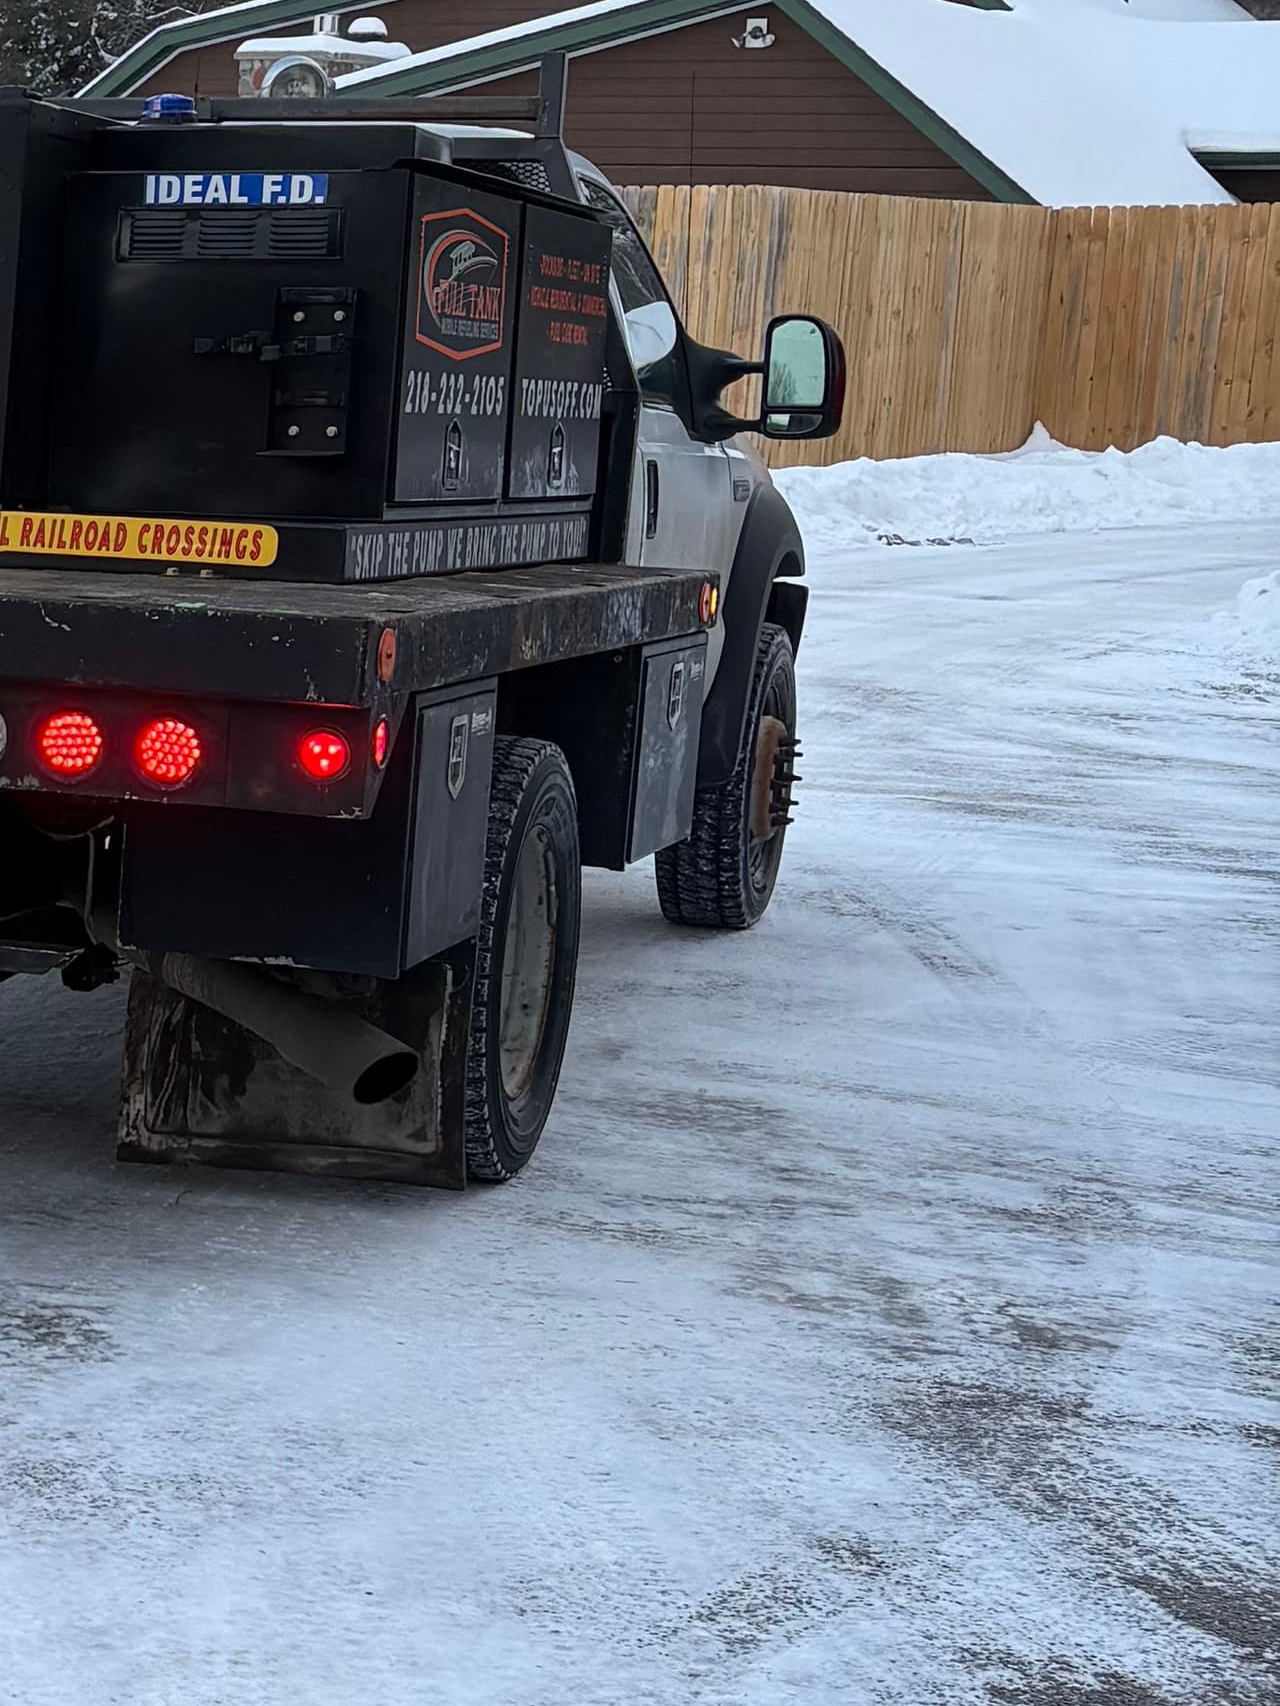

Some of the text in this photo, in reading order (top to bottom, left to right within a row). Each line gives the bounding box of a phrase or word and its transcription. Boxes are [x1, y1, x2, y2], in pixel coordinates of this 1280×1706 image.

[146, 175, 324, 204] IDEAL F.D.
[467, 285, 501, 321] TANK
[405, 370, 505, 416] 218-232-2105
[521, 378, 603, 420] TOPUSOFF.COM
[20, 517, 128, 553] RAILROAD
[137, 523, 264, 561] CROSSINGS
[388, 532, 410, 576] THE
[412, 529, 444, 573] PUMP
[446, 527, 464, 569] WE
[465, 525, 498, 567] BRING
[500, 524, 520, 564] THE
[520, 523, 546, 562] PUMP
[549, 522, 561, 559] TO
